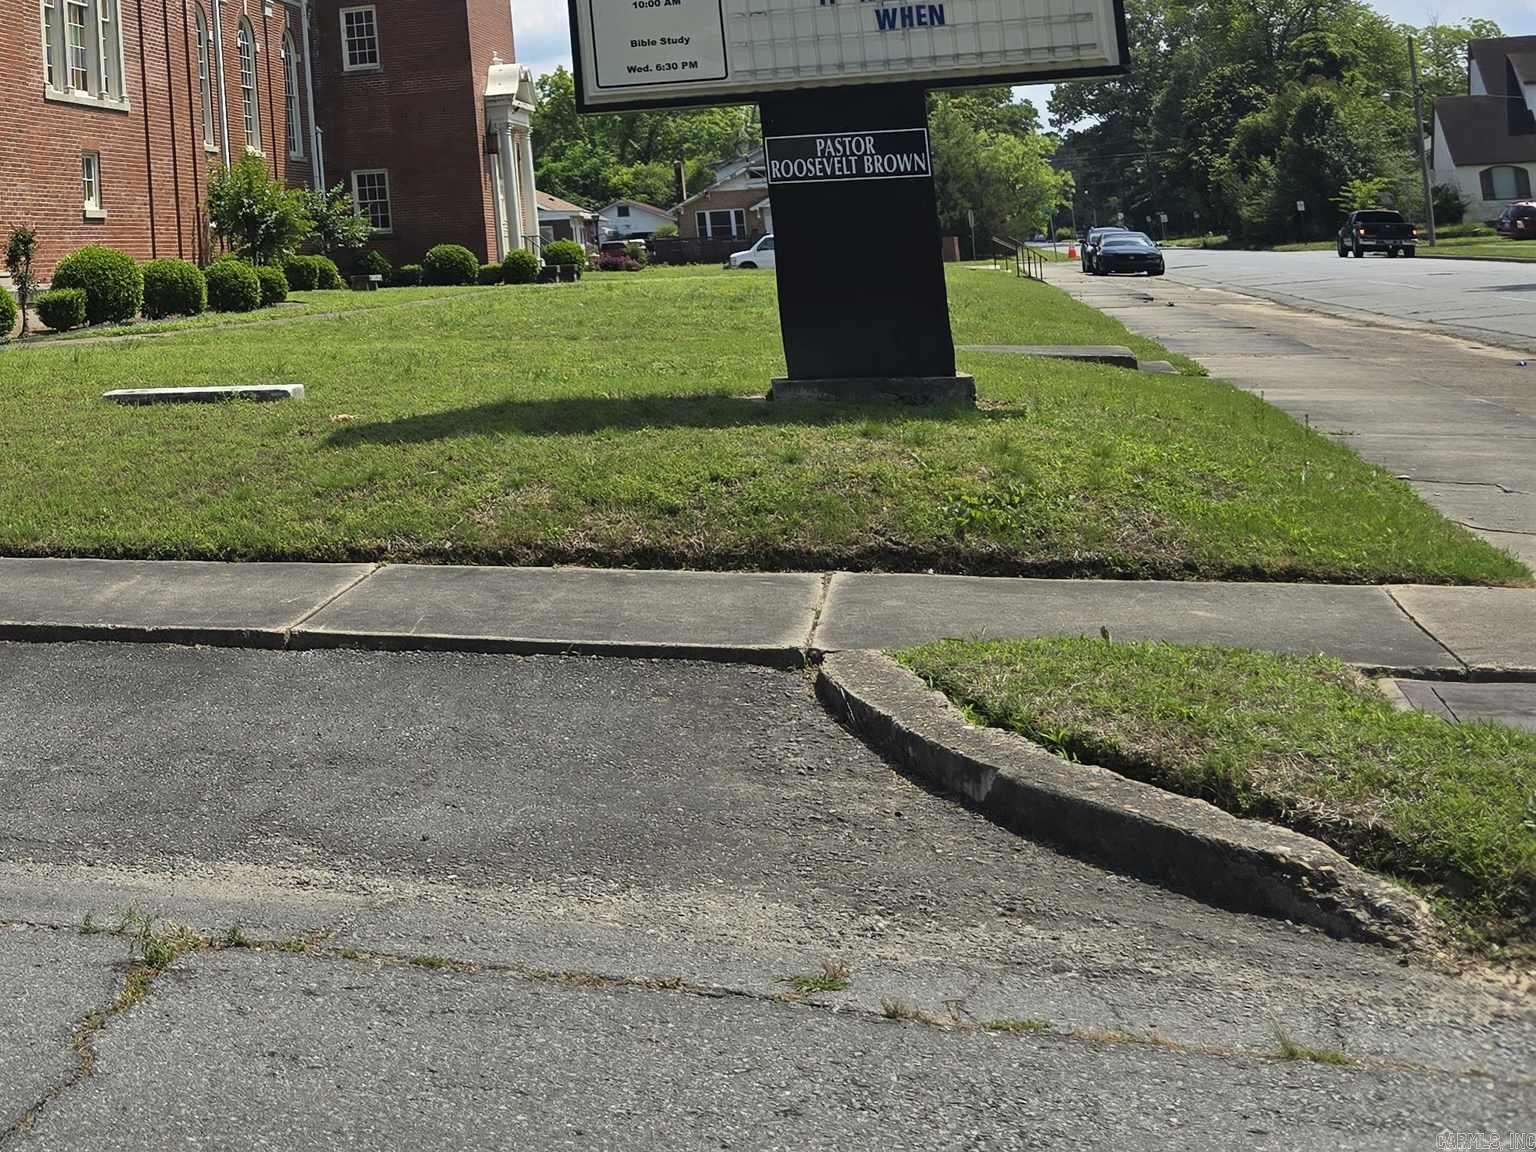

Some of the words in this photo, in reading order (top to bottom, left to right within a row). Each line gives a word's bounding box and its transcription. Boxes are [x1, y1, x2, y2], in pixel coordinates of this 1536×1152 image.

[632, 0, 661, 9] 10:00
[875, 3, 945, 30] WHEN
[630, 38, 657, 48] Bible
[660, 36, 690, 46] Study
[626, 65, 653, 73] Wed.
[655, 62, 678, 72] 6:30
[681, 60, 698, 69] PM
[815, 136, 876, 157] PASTOR
[771, 156, 858, 179] ROOSEVELT
[864, 152, 927, 174] BROWN
